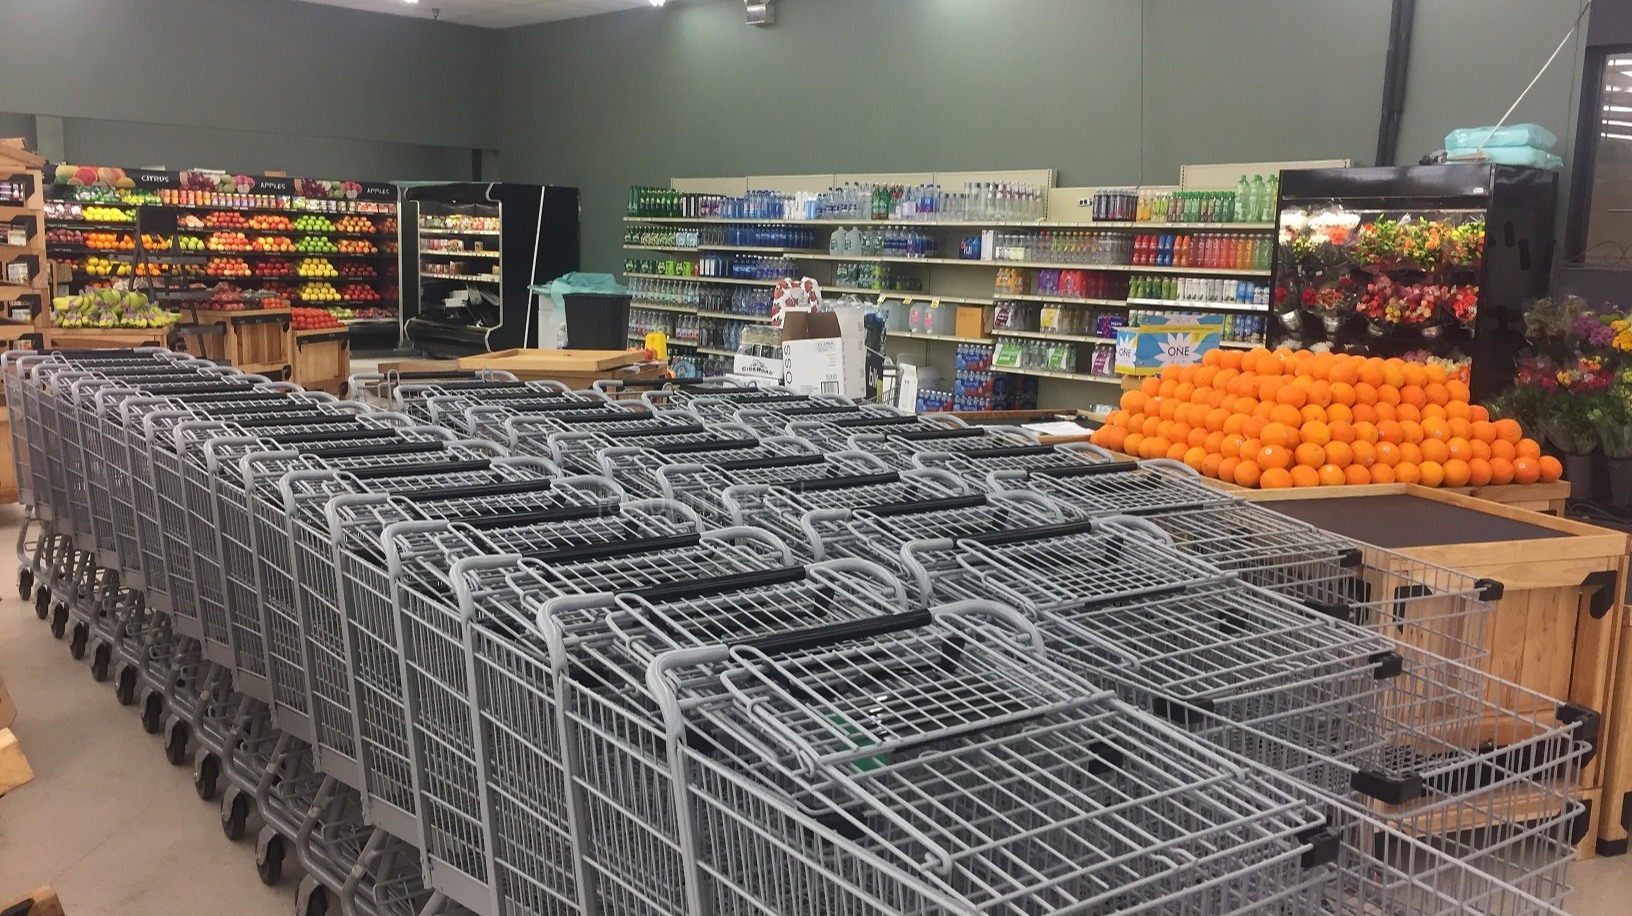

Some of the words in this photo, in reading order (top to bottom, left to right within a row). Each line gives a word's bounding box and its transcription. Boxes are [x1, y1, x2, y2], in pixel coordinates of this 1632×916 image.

[141, 175, 170, 183] CITRUS
[260, 181, 286, 190] APPLES
[366, 187, 390, 195] APPLES
[1118, 347, 1131, 358] ONE
[1167, 346, 1190, 357] ONE
